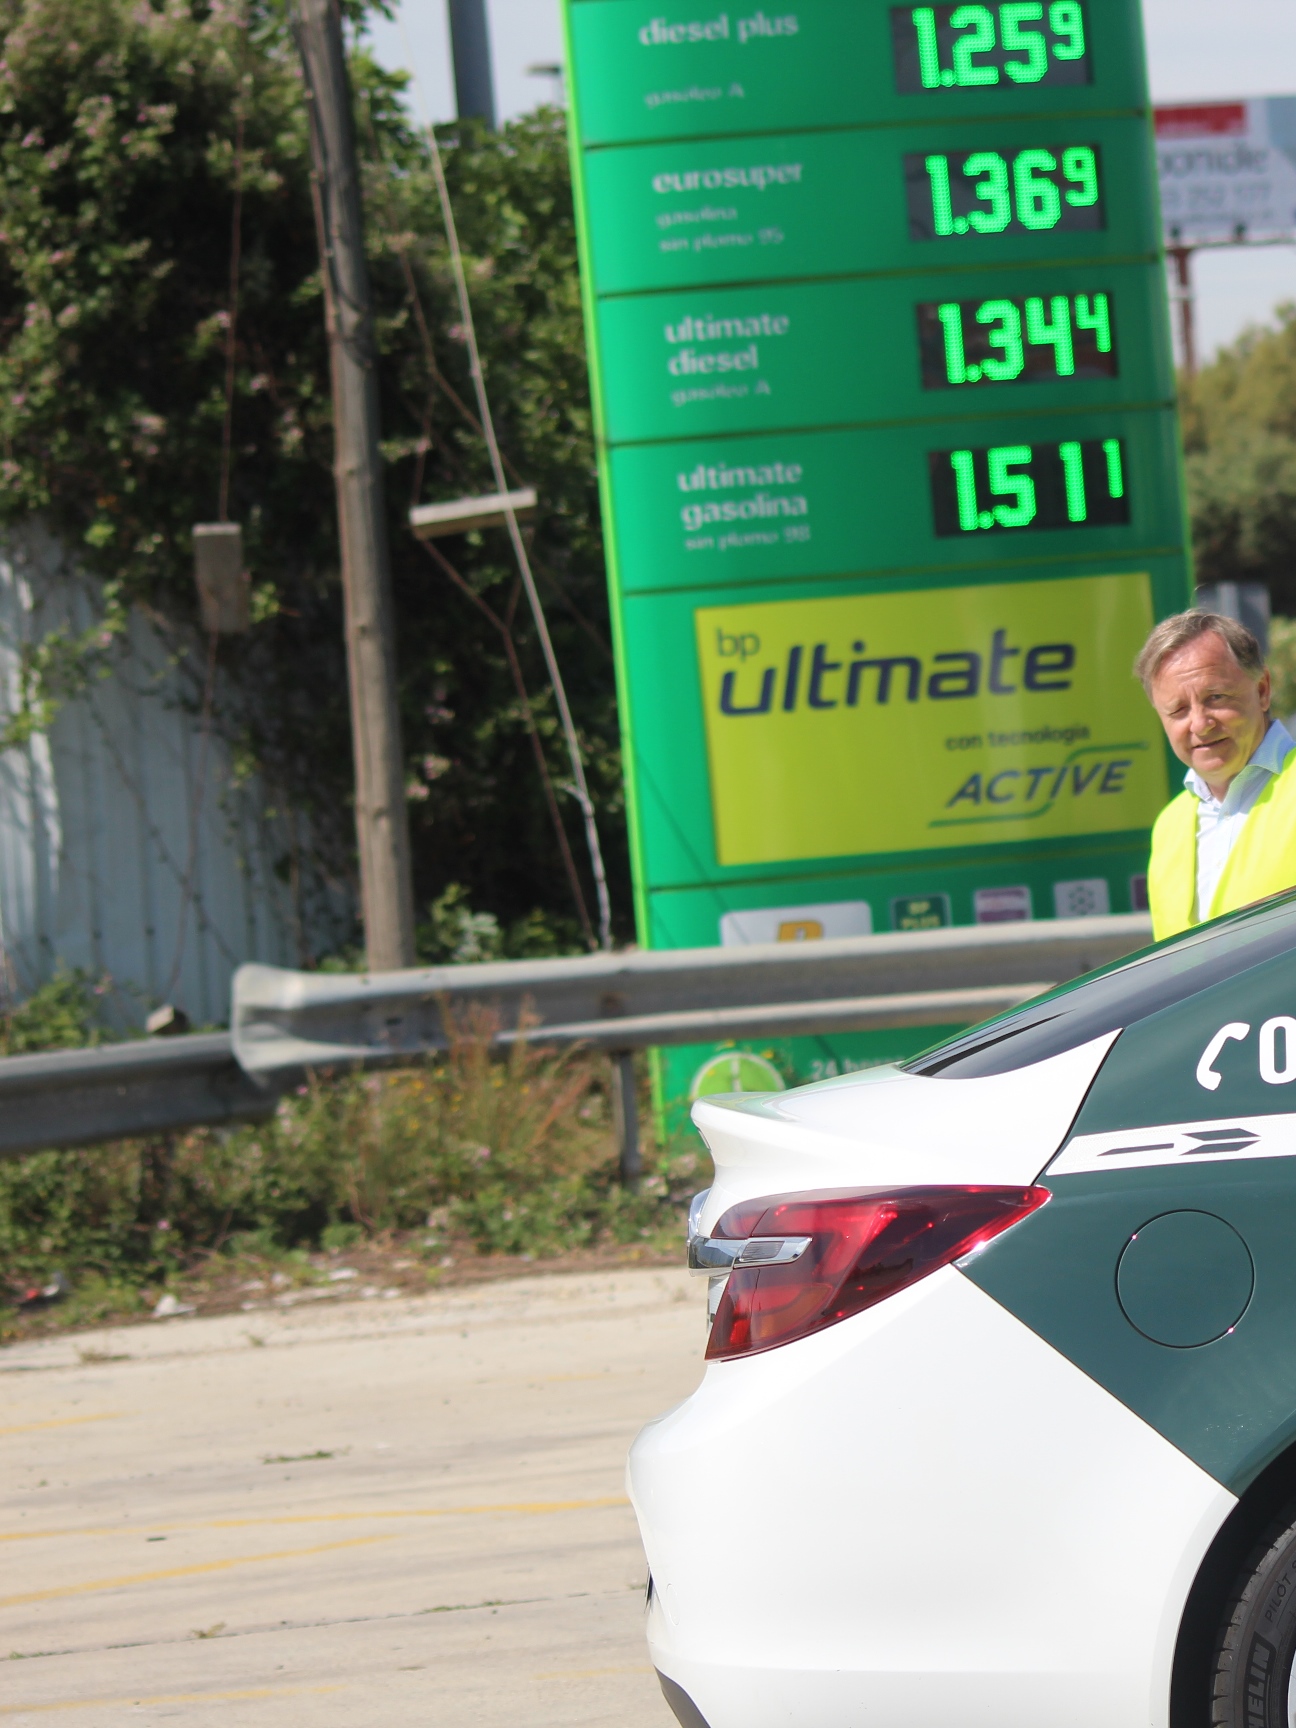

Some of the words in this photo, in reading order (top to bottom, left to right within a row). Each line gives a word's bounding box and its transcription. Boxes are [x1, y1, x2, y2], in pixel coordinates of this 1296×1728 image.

[639, 13, 729, 45] diesel
[737, 12, 799, 43] plus
[652, 163, 803, 192] eurosuper
[925, 147, 1098, 236] 1.369
[664, 313, 789, 343] ultimate
[938, 293, 1111, 384] 1.344
[668, 344, 758, 376] diesel
[677, 461, 802, 491] ultimate
[951, 439, 1123, 530] 1.511
[681, 492, 808, 530] gasolina
[716, 628, 760, 662] bp
[719, 629, 1075, 717] ultimate
[945, 734, 983, 750] con
[946, 760, 1132, 808] ACTIVE
[1265, 1573, 1291, 1622] PILOT
